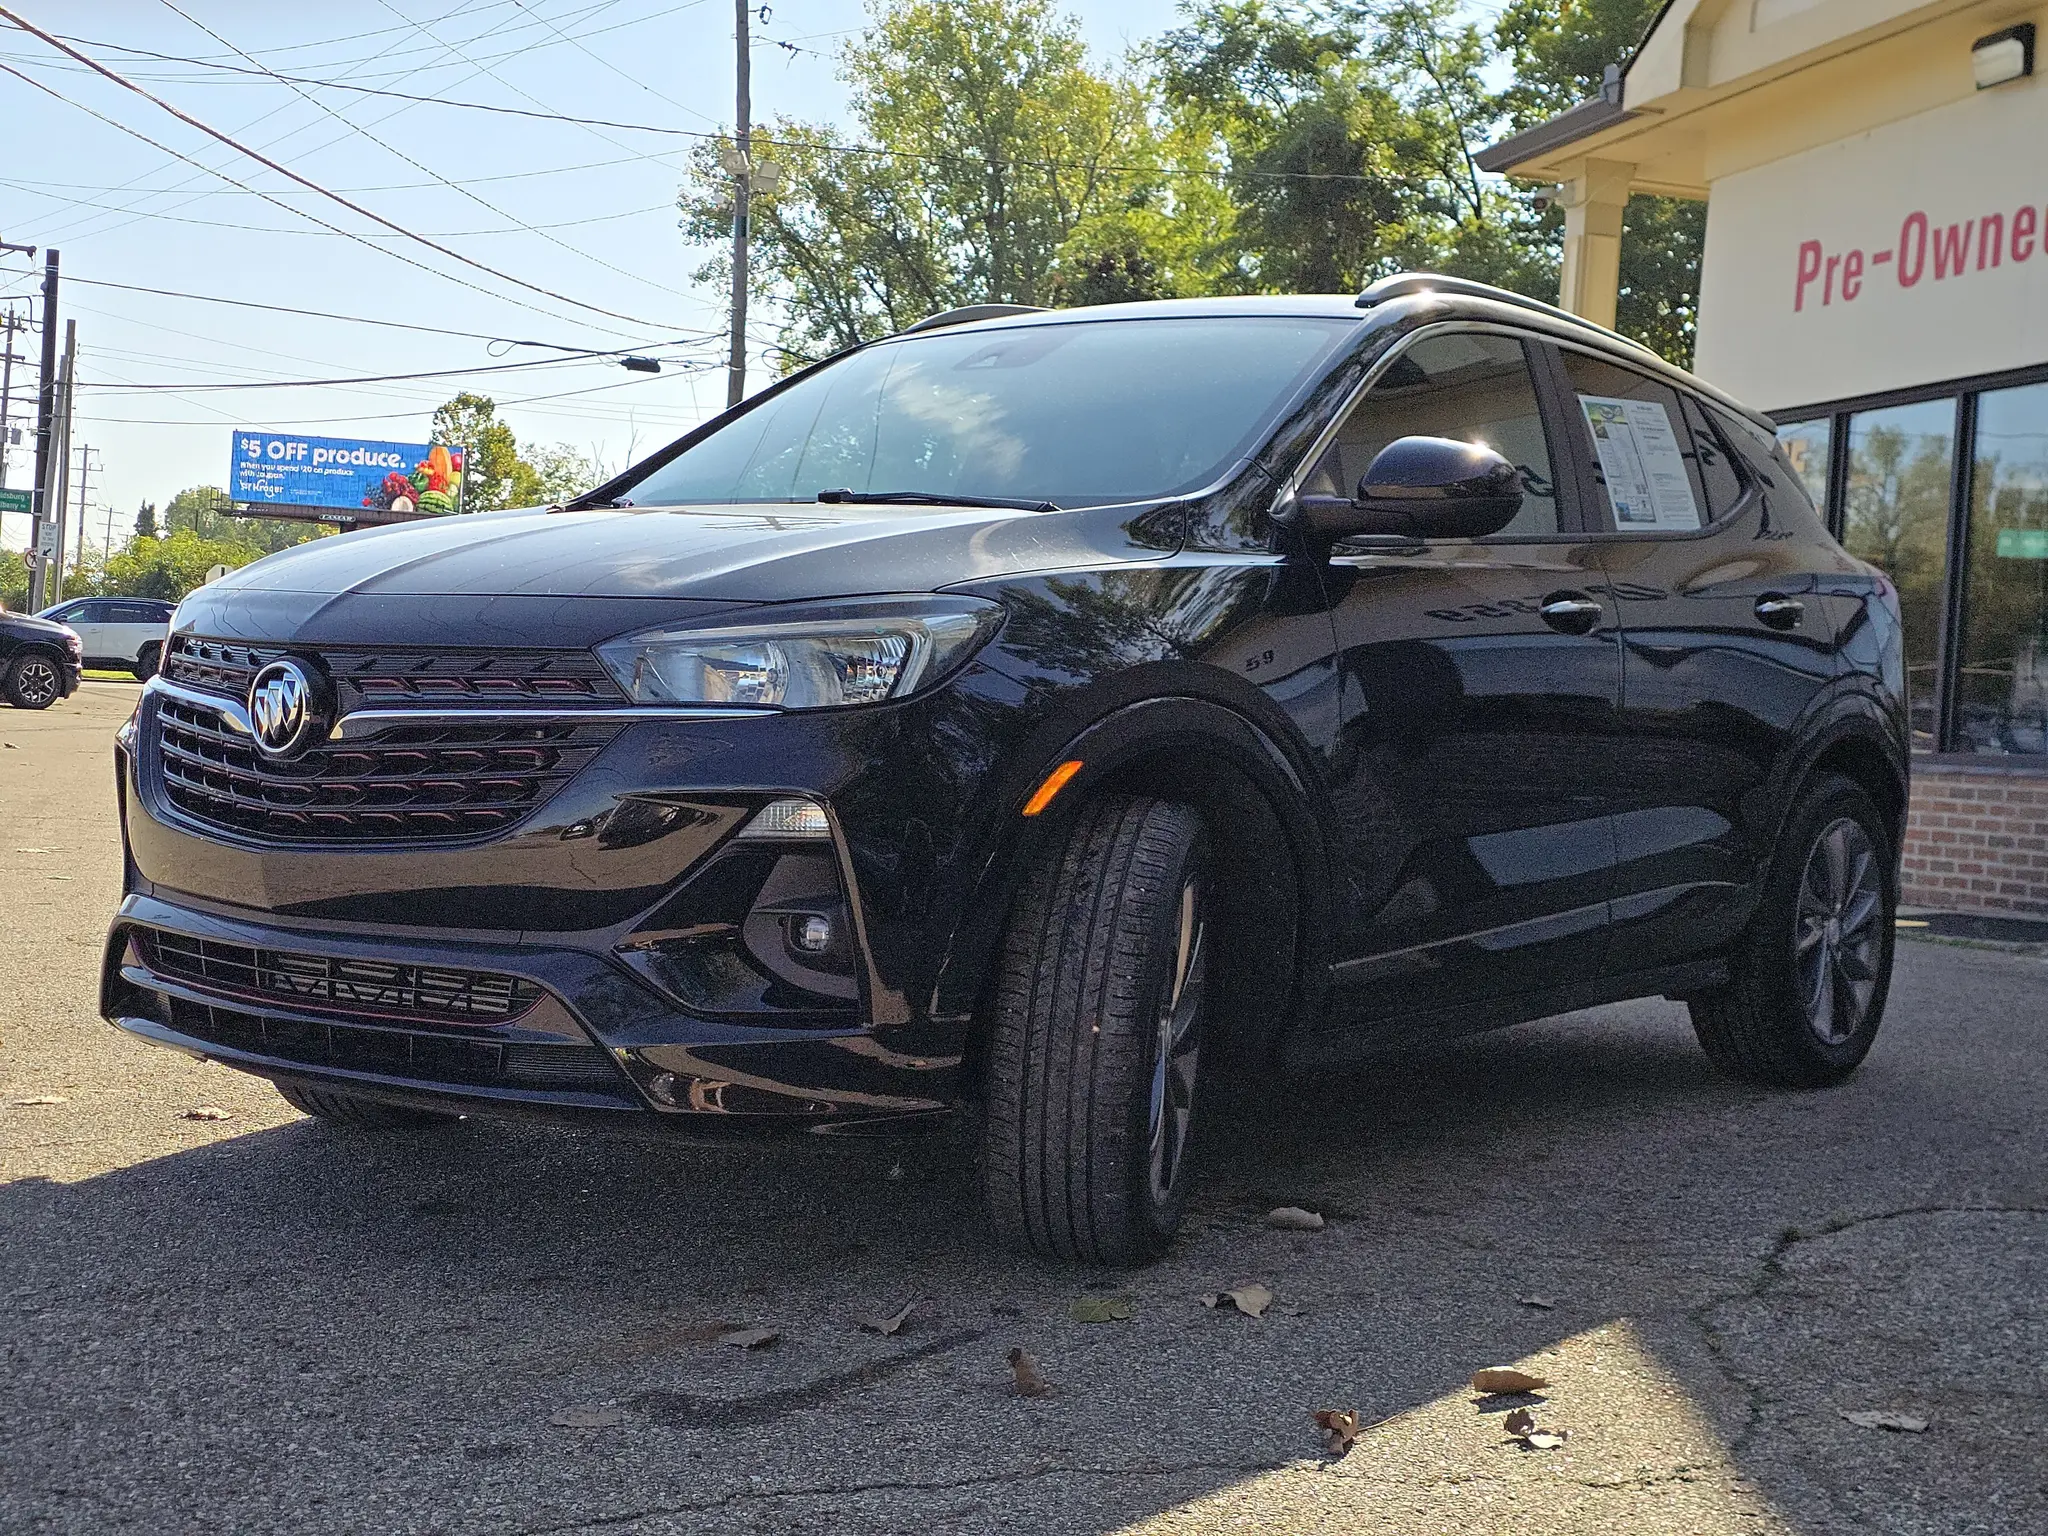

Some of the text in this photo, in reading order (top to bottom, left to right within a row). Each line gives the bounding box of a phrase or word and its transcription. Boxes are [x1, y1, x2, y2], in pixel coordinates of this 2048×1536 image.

[1794, 204, 2048, 313] Pre-Owne
[241, 438, 406, 468] $5 OFF produce.
[277, 465, 299, 473] spend
